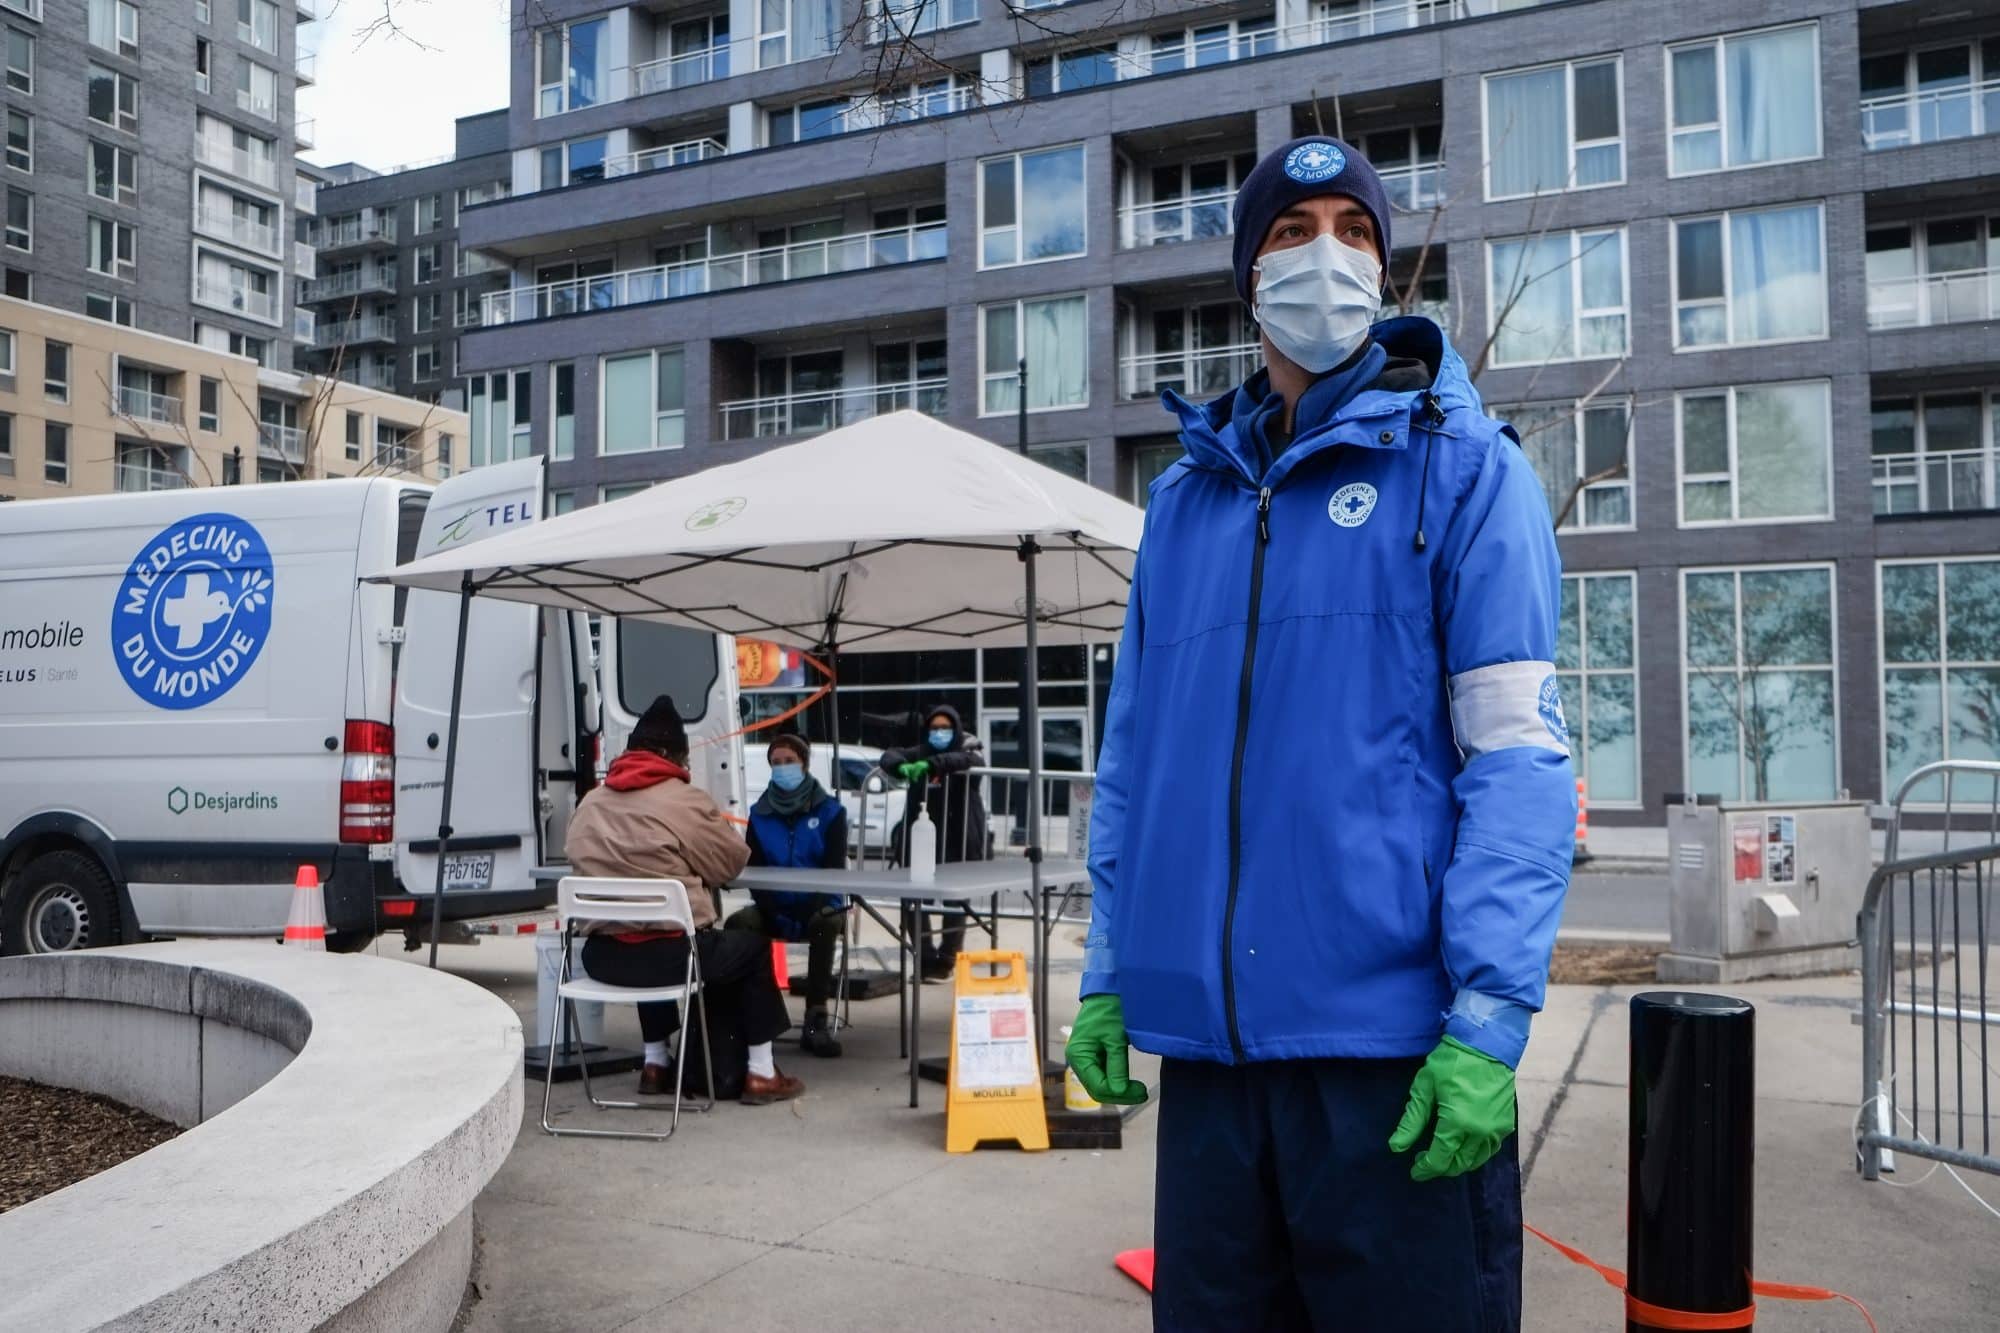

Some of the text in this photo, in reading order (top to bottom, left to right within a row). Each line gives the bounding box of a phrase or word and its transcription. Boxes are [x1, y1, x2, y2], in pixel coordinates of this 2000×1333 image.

[486, 502, 533, 527] TEL
[122, 525, 250, 615] MÉDECINS
[1, 620, 84, 650] mobile
[122, 629, 255, 698] DU MONDE
[194, 791, 278, 814] Desjardins
